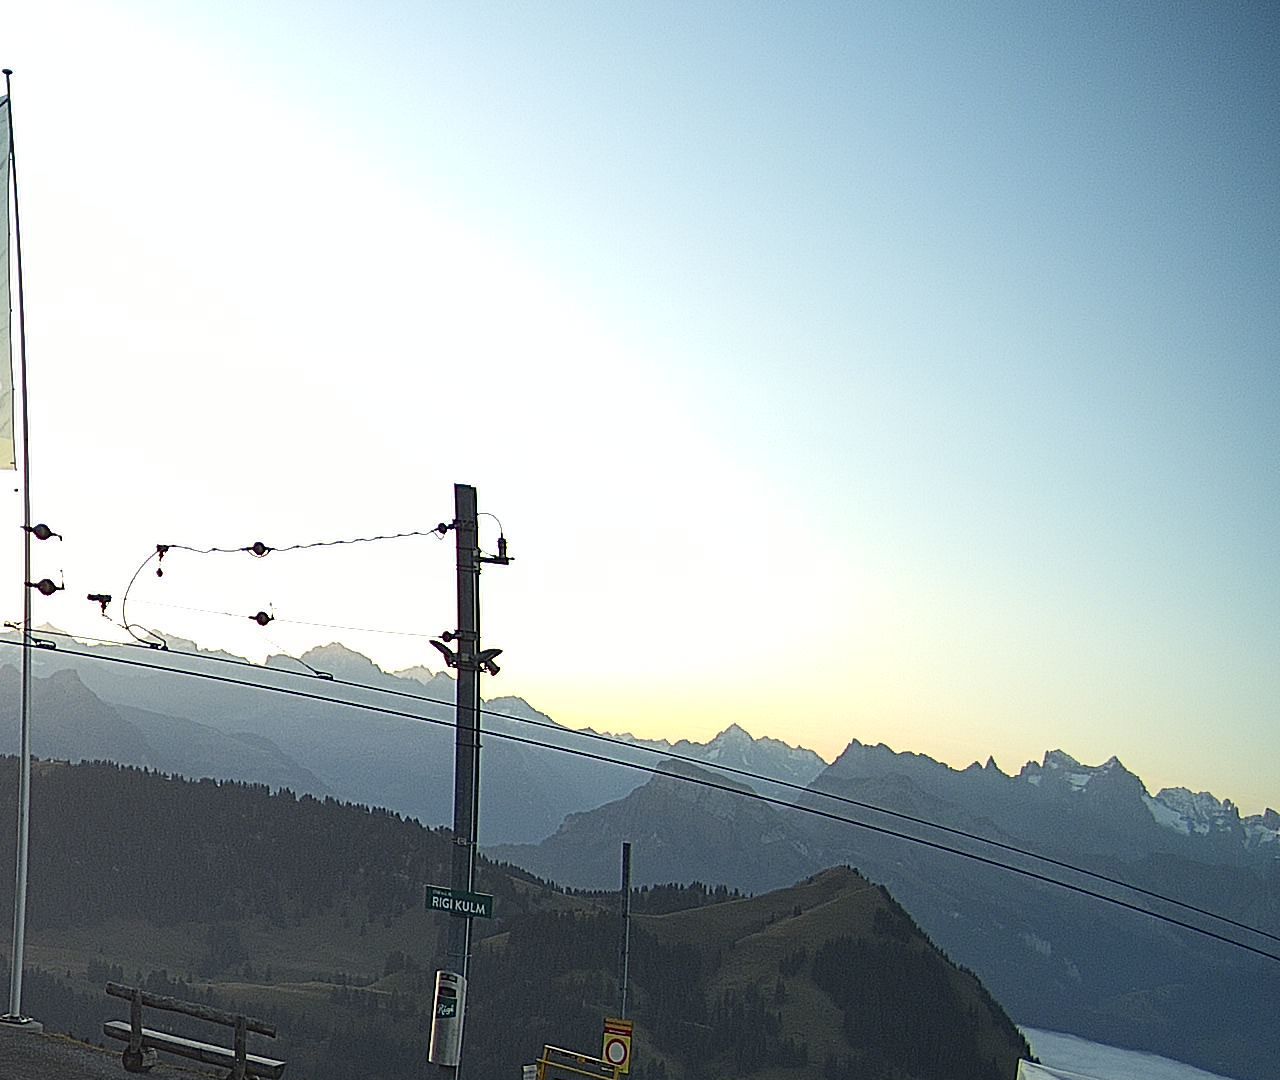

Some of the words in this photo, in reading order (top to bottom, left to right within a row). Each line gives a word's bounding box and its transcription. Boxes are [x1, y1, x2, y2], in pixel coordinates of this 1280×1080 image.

[432, 896, 453, 909] RIGI
[455, 900, 486, 915] KULM
[437, 1003, 454, 1016] Rigi
